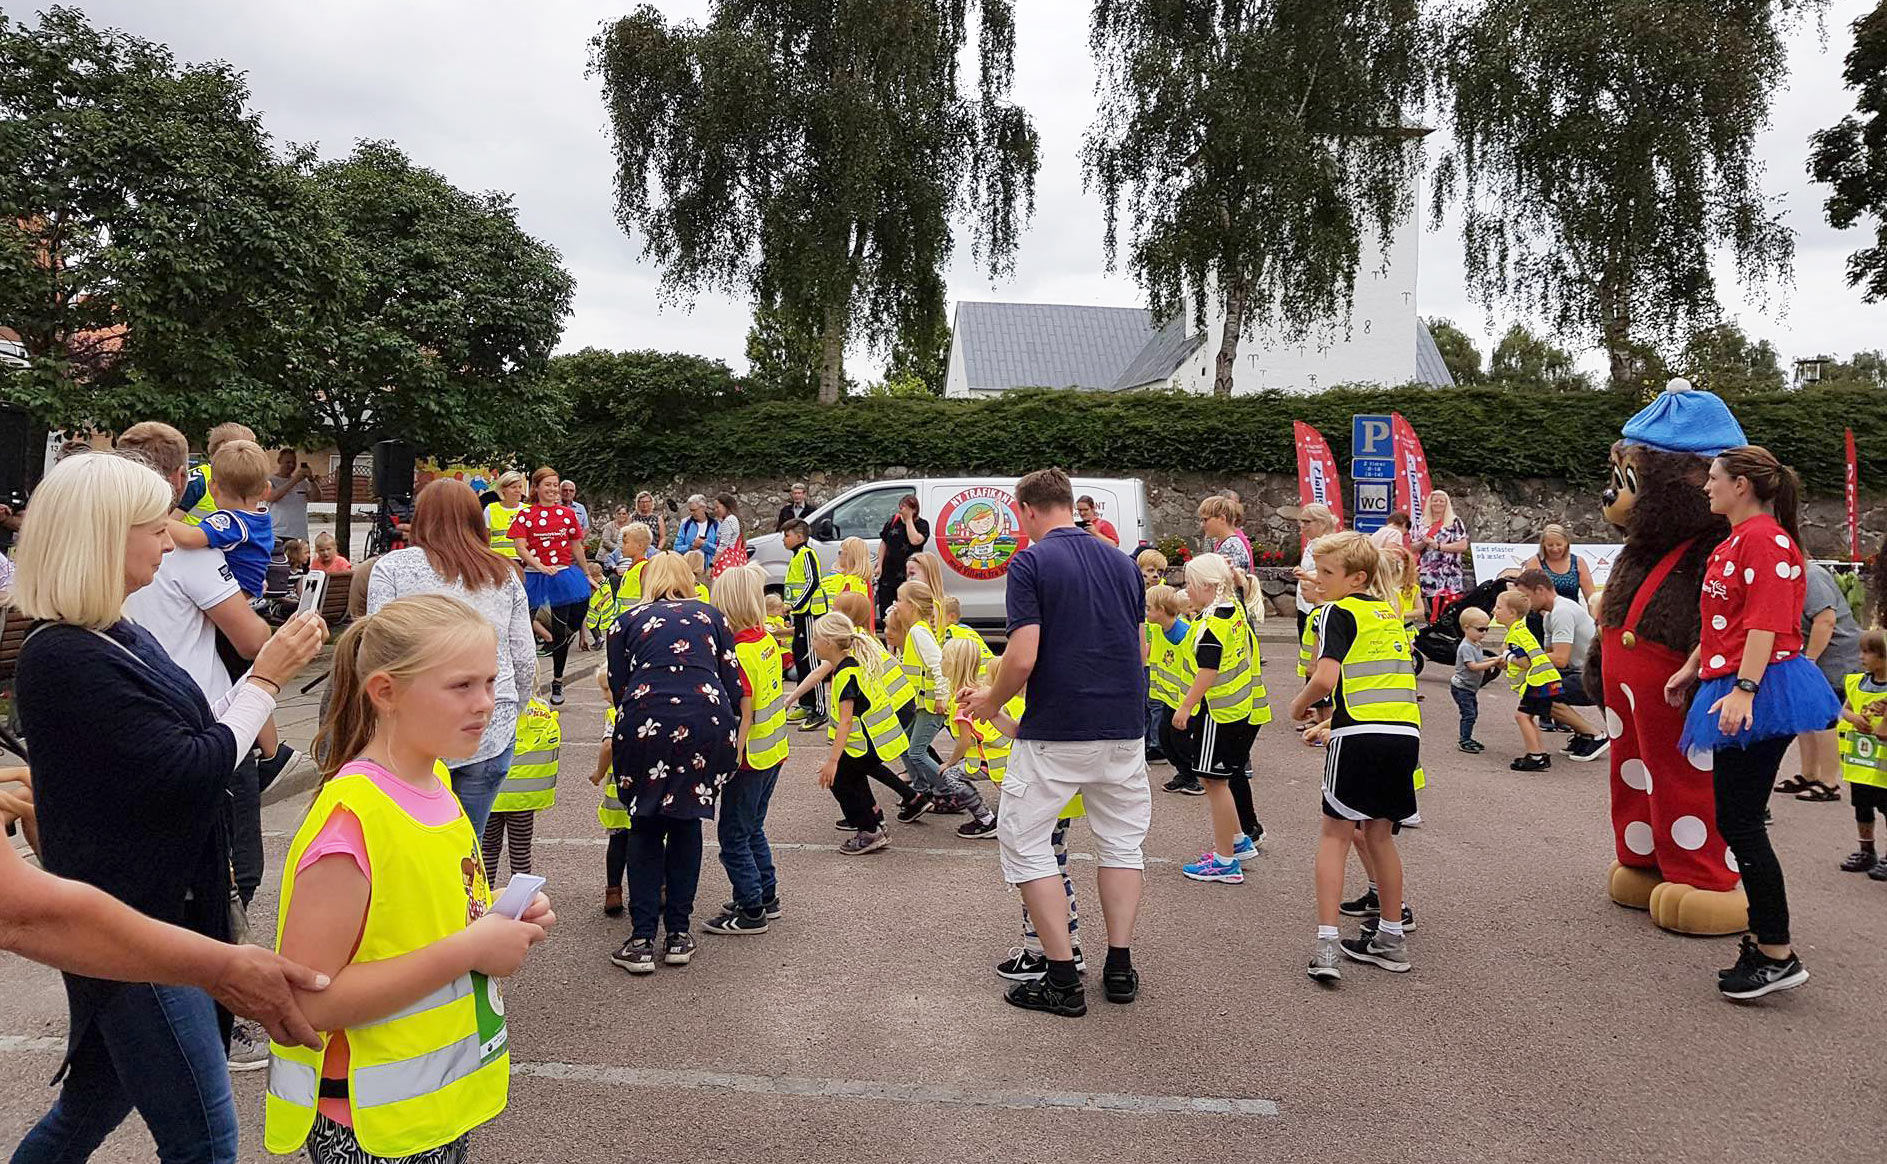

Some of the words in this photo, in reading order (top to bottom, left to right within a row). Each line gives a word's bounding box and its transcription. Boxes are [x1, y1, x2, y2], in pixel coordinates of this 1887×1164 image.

[1361, 420, 1390, 453] P
[950, 495, 964, 508] NY
[963, 488, 1015, 506] TRAFIKANT
[1360, 497, 1387, 510] WC
